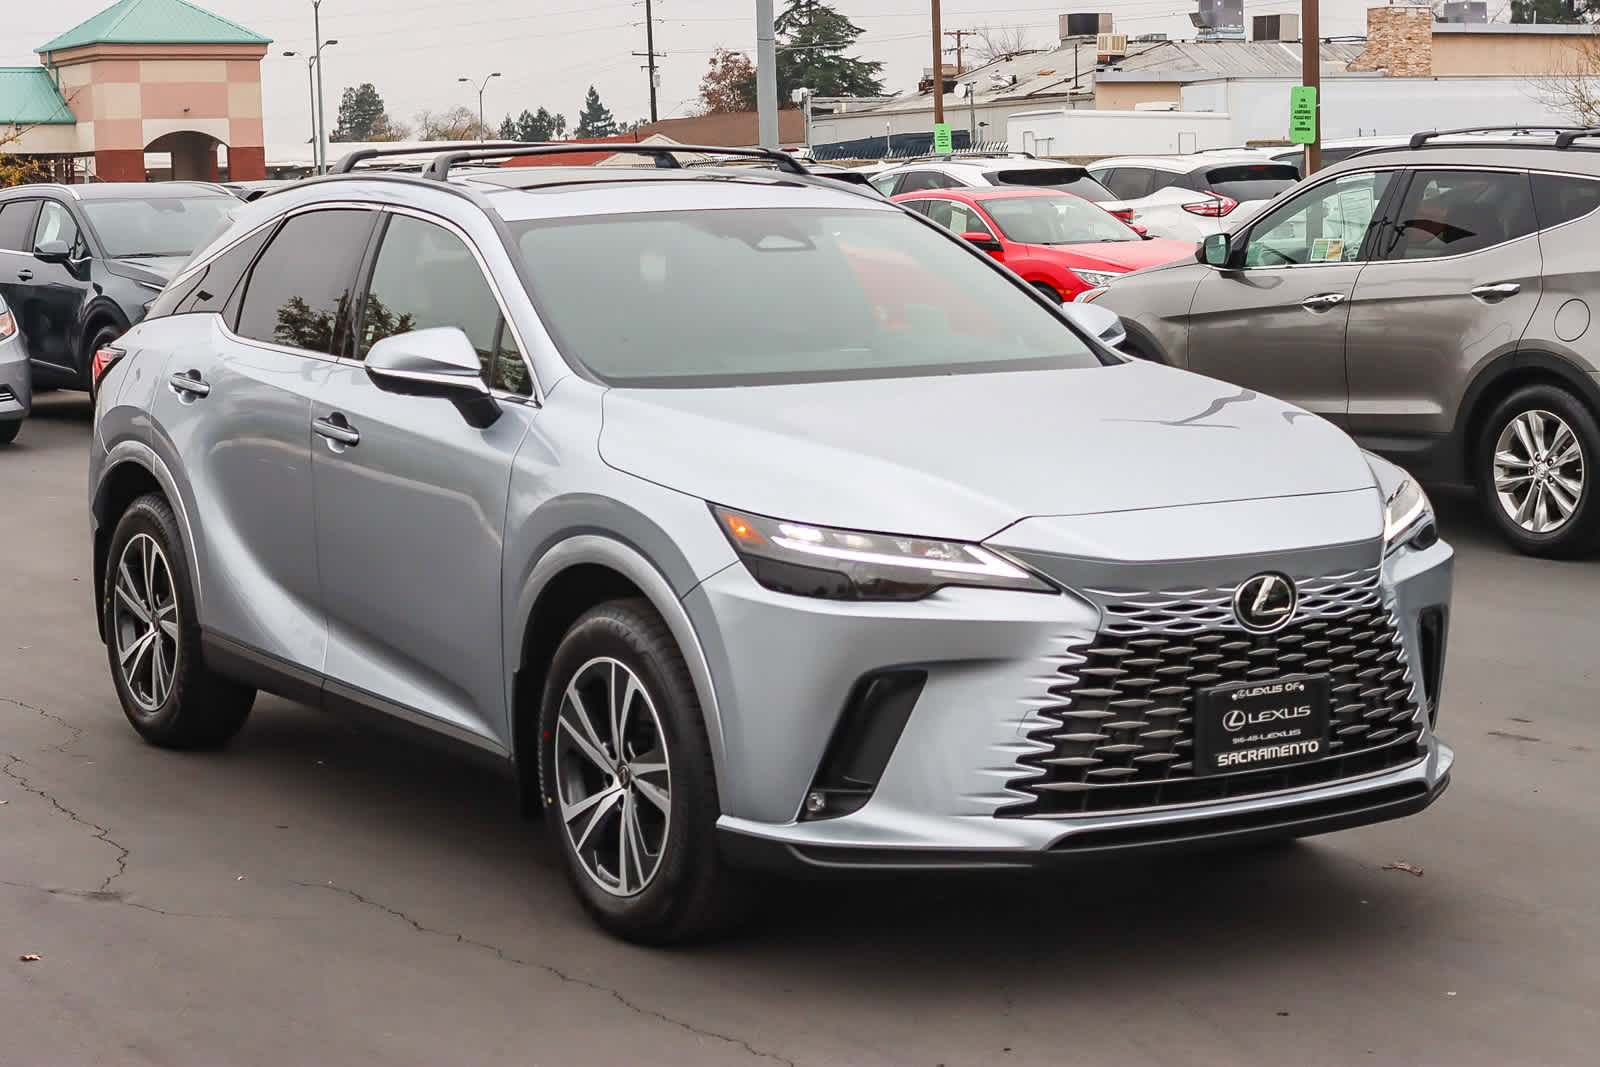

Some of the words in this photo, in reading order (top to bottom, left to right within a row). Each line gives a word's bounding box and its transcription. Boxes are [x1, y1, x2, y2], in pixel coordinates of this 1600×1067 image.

[1246, 685, 1283, 697] LEXUS
[1285, 682, 1300, 692] OF
[1248, 705, 1311, 724] LEXUS
[1217, 740, 1320, 767] SACRAMENTO
